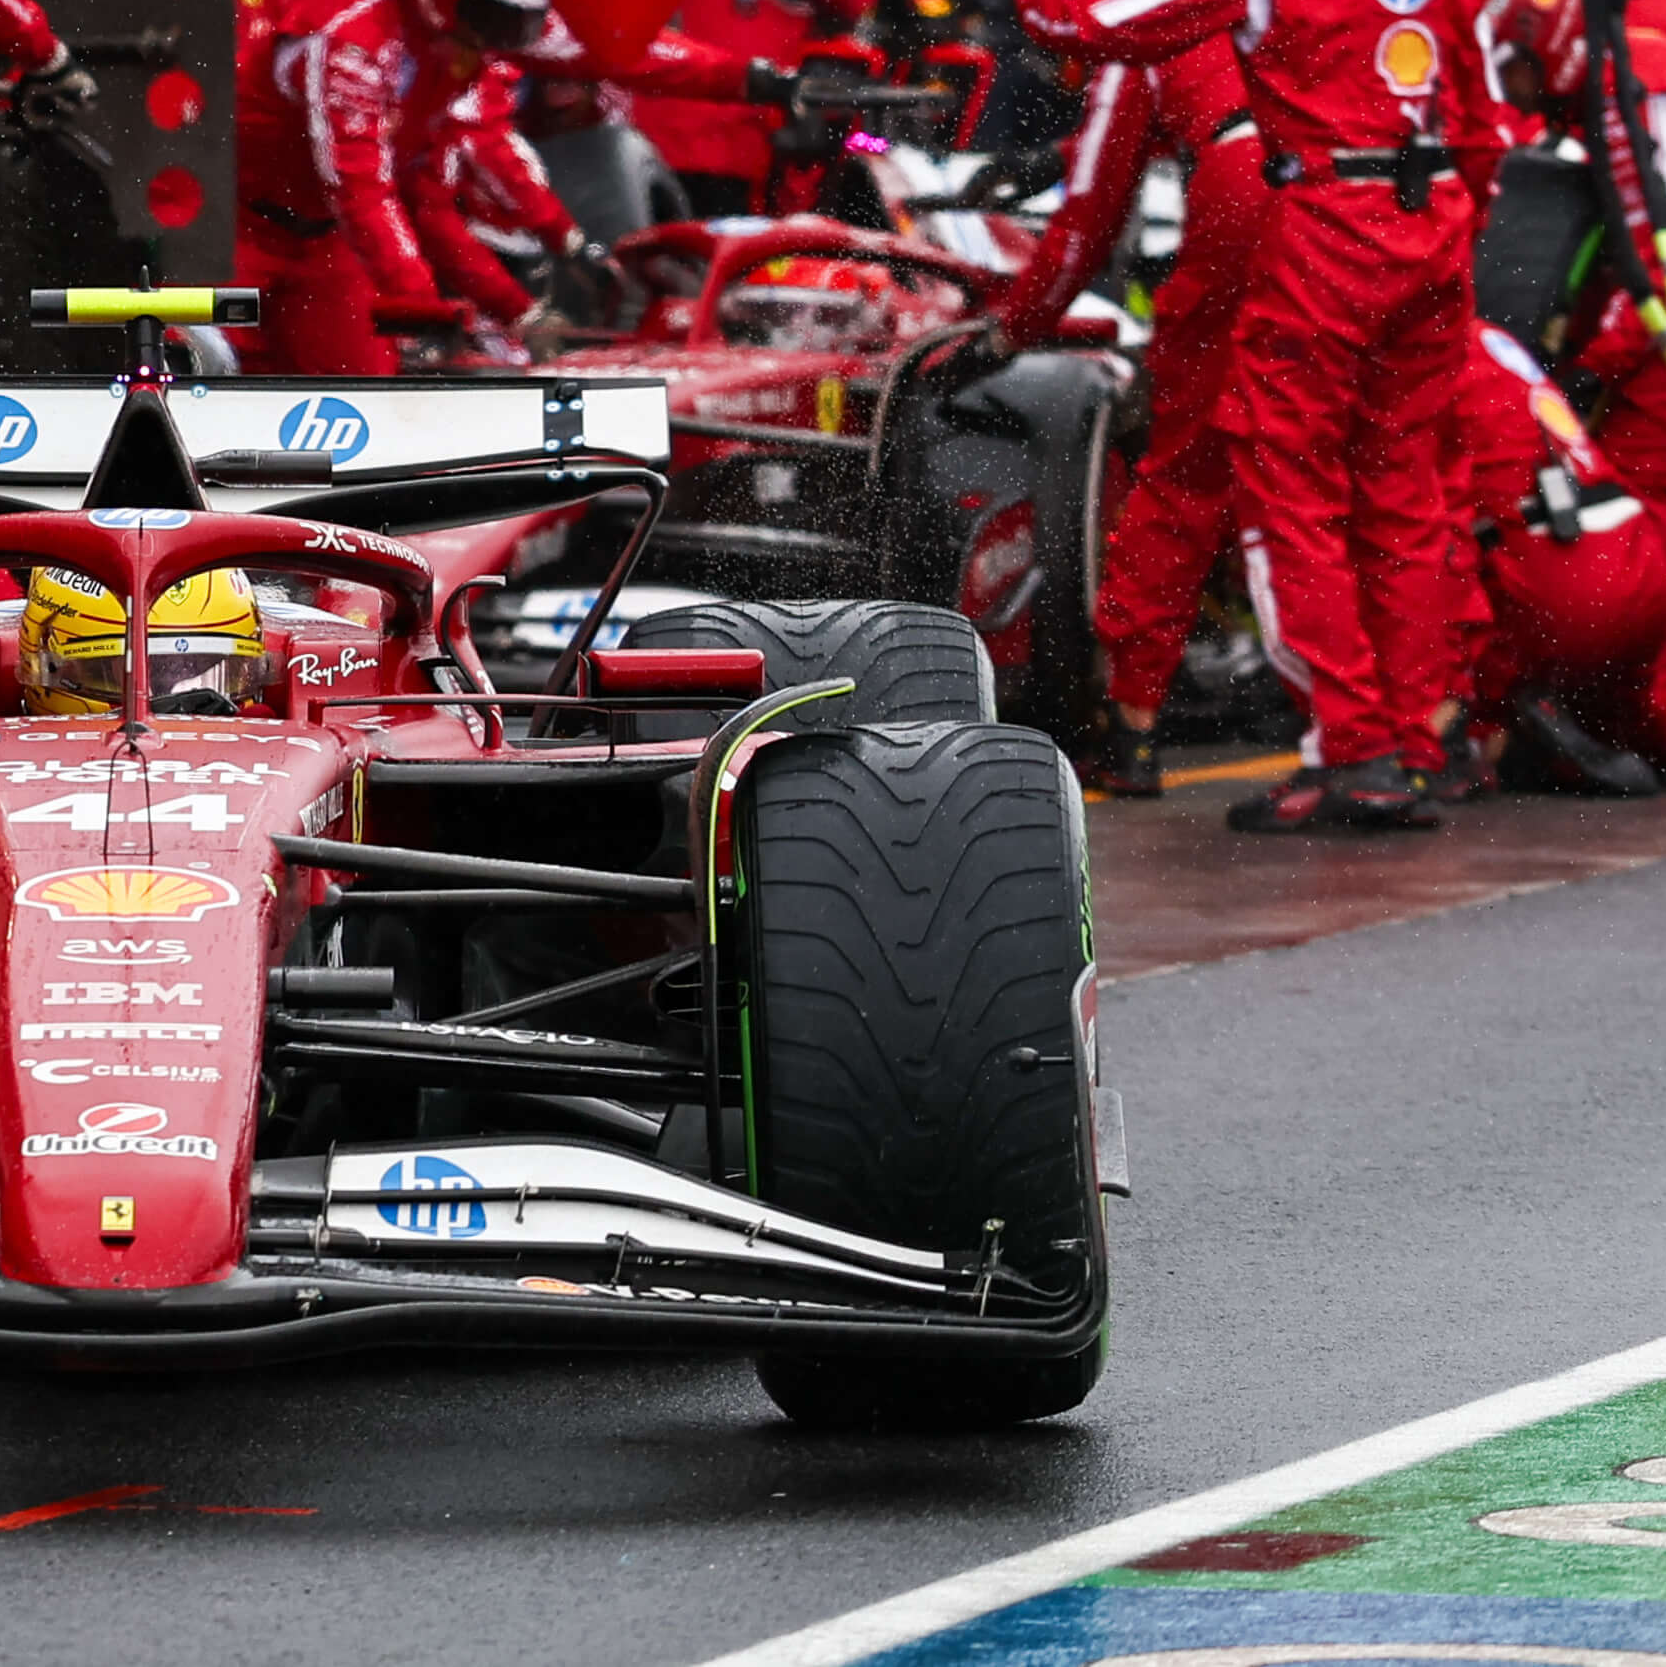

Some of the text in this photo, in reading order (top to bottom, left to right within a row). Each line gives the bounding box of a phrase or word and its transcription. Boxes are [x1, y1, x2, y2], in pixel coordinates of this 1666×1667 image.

[288, 397, 363, 463] hp
[288, 647, 379, 686] Ray-Ban
[6, 770, 264, 784] POKER
[9, 793, 245, 831] 44
[62, 937, 187, 955] aws
[42, 982, 204, 1006] IBM
[20, 1022, 223, 1041] PIRELLI
[92, 1065, 219, 1078] CELSIUS
[24, 1134, 215, 1158] UniCredit
[395, 1157, 477, 1238] hp
